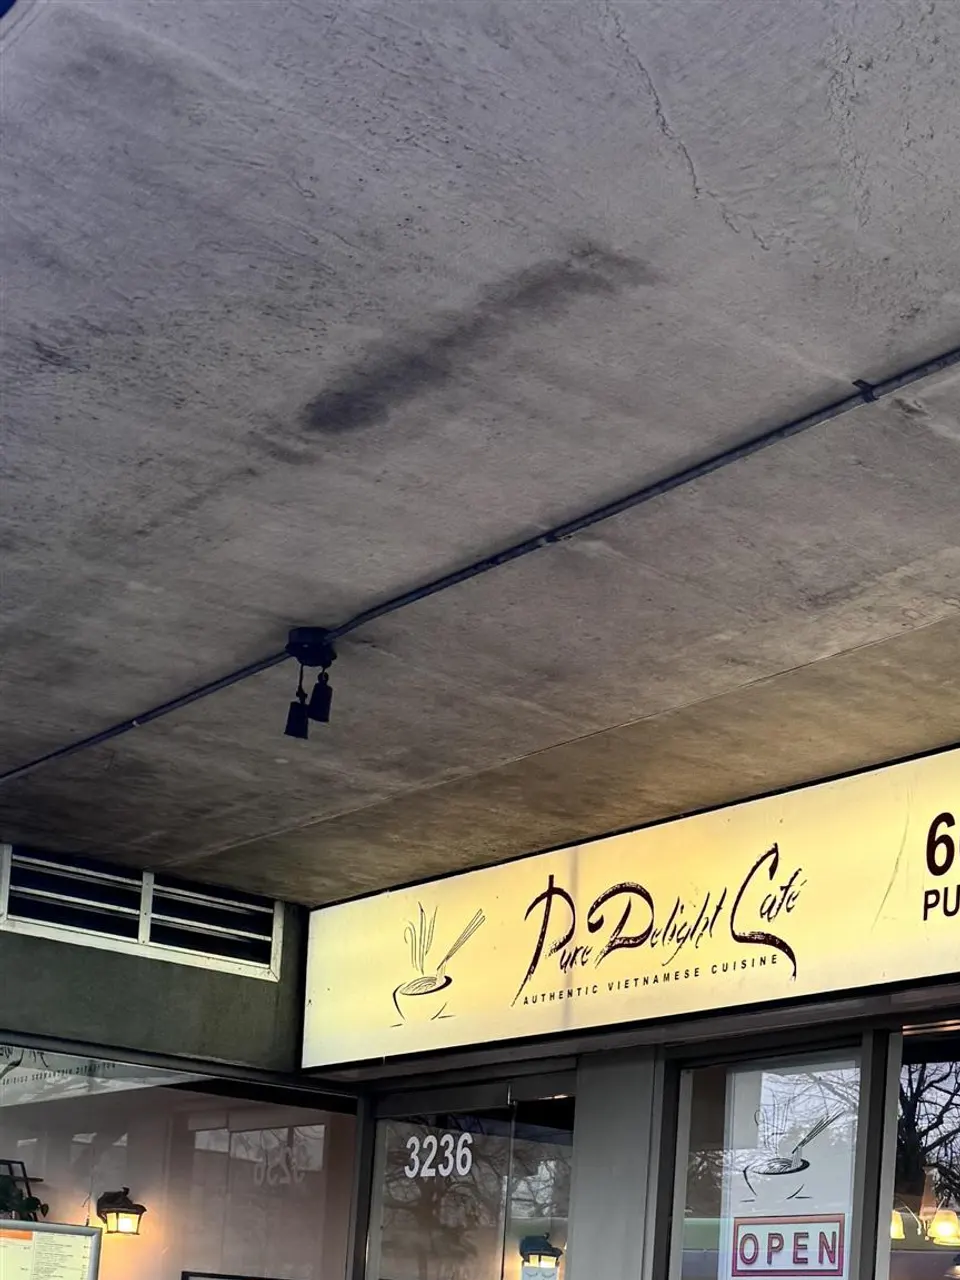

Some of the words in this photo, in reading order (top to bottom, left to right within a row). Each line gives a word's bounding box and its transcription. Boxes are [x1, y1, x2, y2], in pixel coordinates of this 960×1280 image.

[511, 874, 593, 1007] Pure
[587, 881, 728, 967] Delight
[730, 842, 807, 982] Café
[523, 985, 598, 1005] AUTHENTIC
[608, 967, 700, 991] VIETNAMESE
[711, 953, 778, 975] CUISINE
[404, 1132, 473, 1178] 3236
[739, 1231, 836, 1266] OPEN
